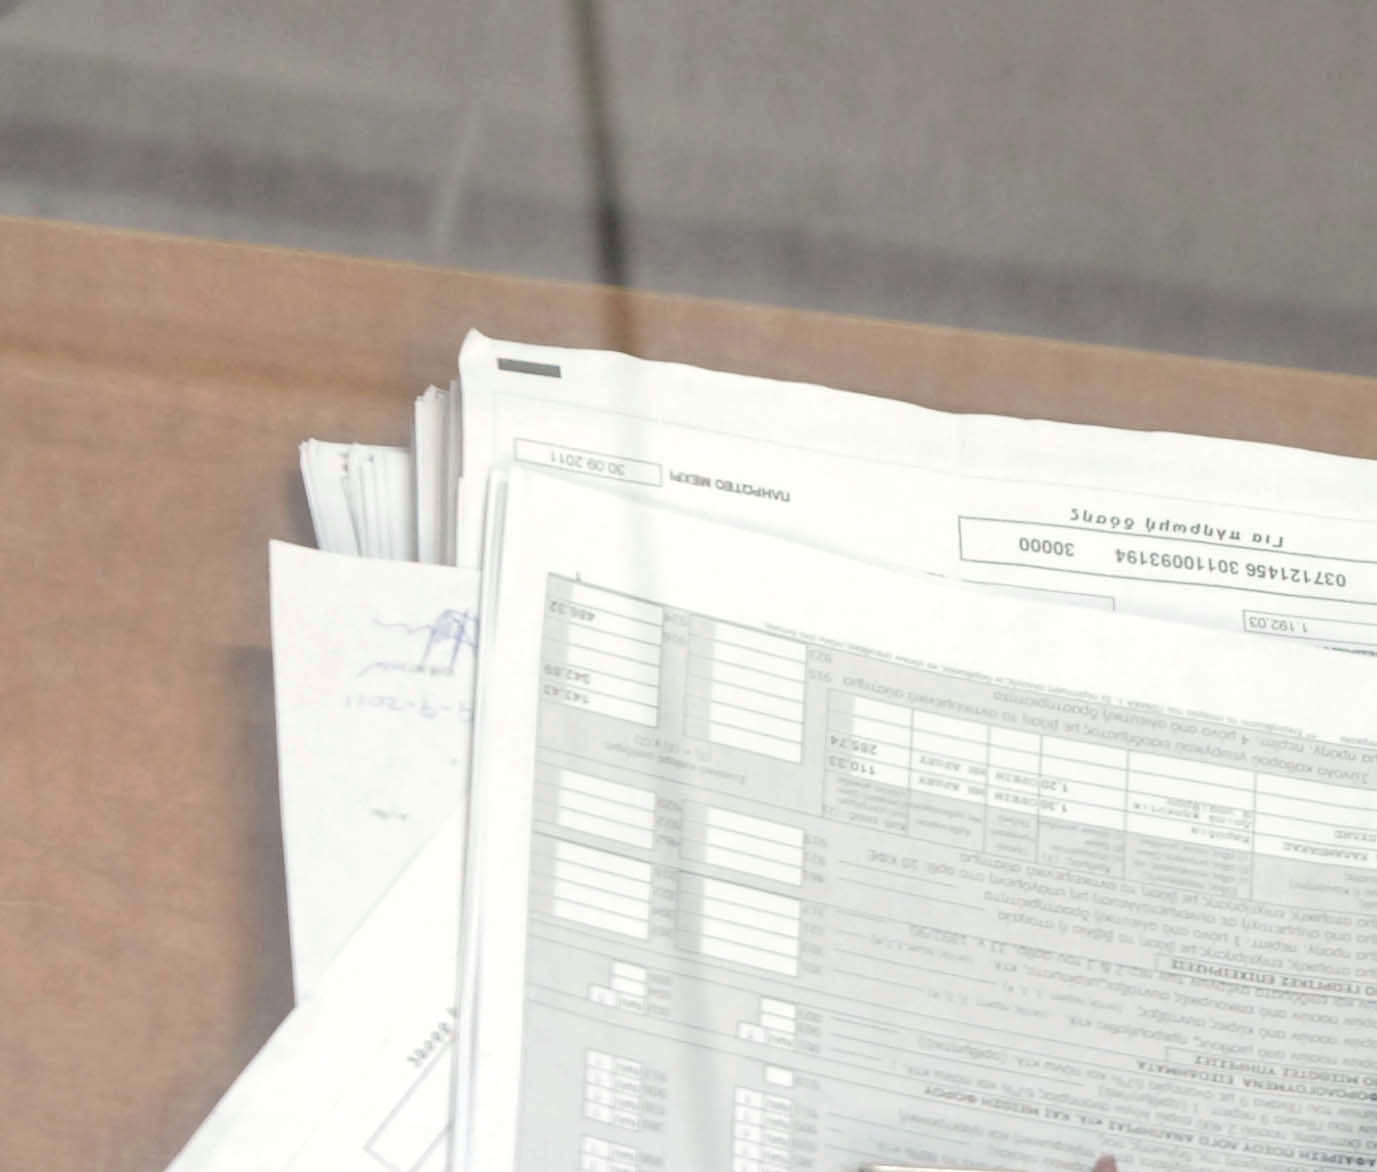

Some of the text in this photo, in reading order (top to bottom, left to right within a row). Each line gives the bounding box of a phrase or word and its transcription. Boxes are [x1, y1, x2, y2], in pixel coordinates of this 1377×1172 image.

[549, 451, 625, 477] 30.09.2011
[669, 470, 711, 488] ΜΕΧΡΙ
[1070, 508, 1284, 547] Για πληρωμή δόσης
[1018, 537, 1347, 589] 037121456 30110093194 30000
